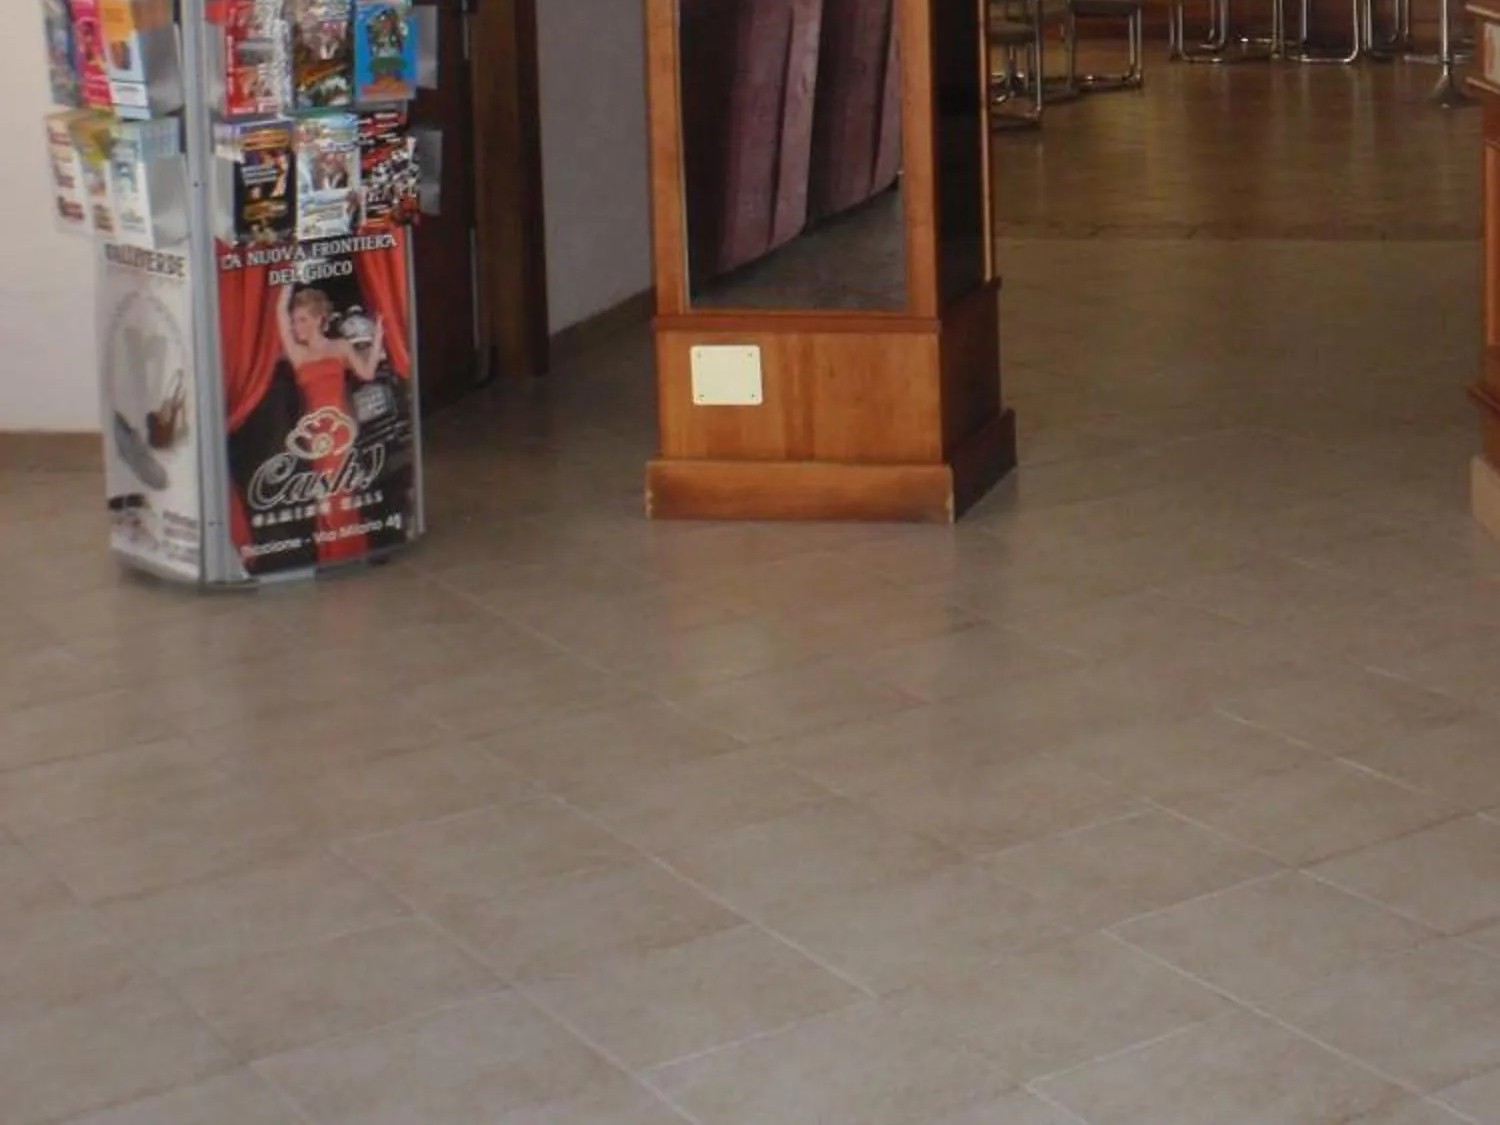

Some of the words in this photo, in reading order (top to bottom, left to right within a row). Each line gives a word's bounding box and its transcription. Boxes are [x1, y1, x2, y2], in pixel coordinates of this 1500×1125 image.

[247, 244, 308, 266] NUOVA
[312, 233, 397, 258] FRONTIERA
[303, 260, 353, 283] GIOCO
